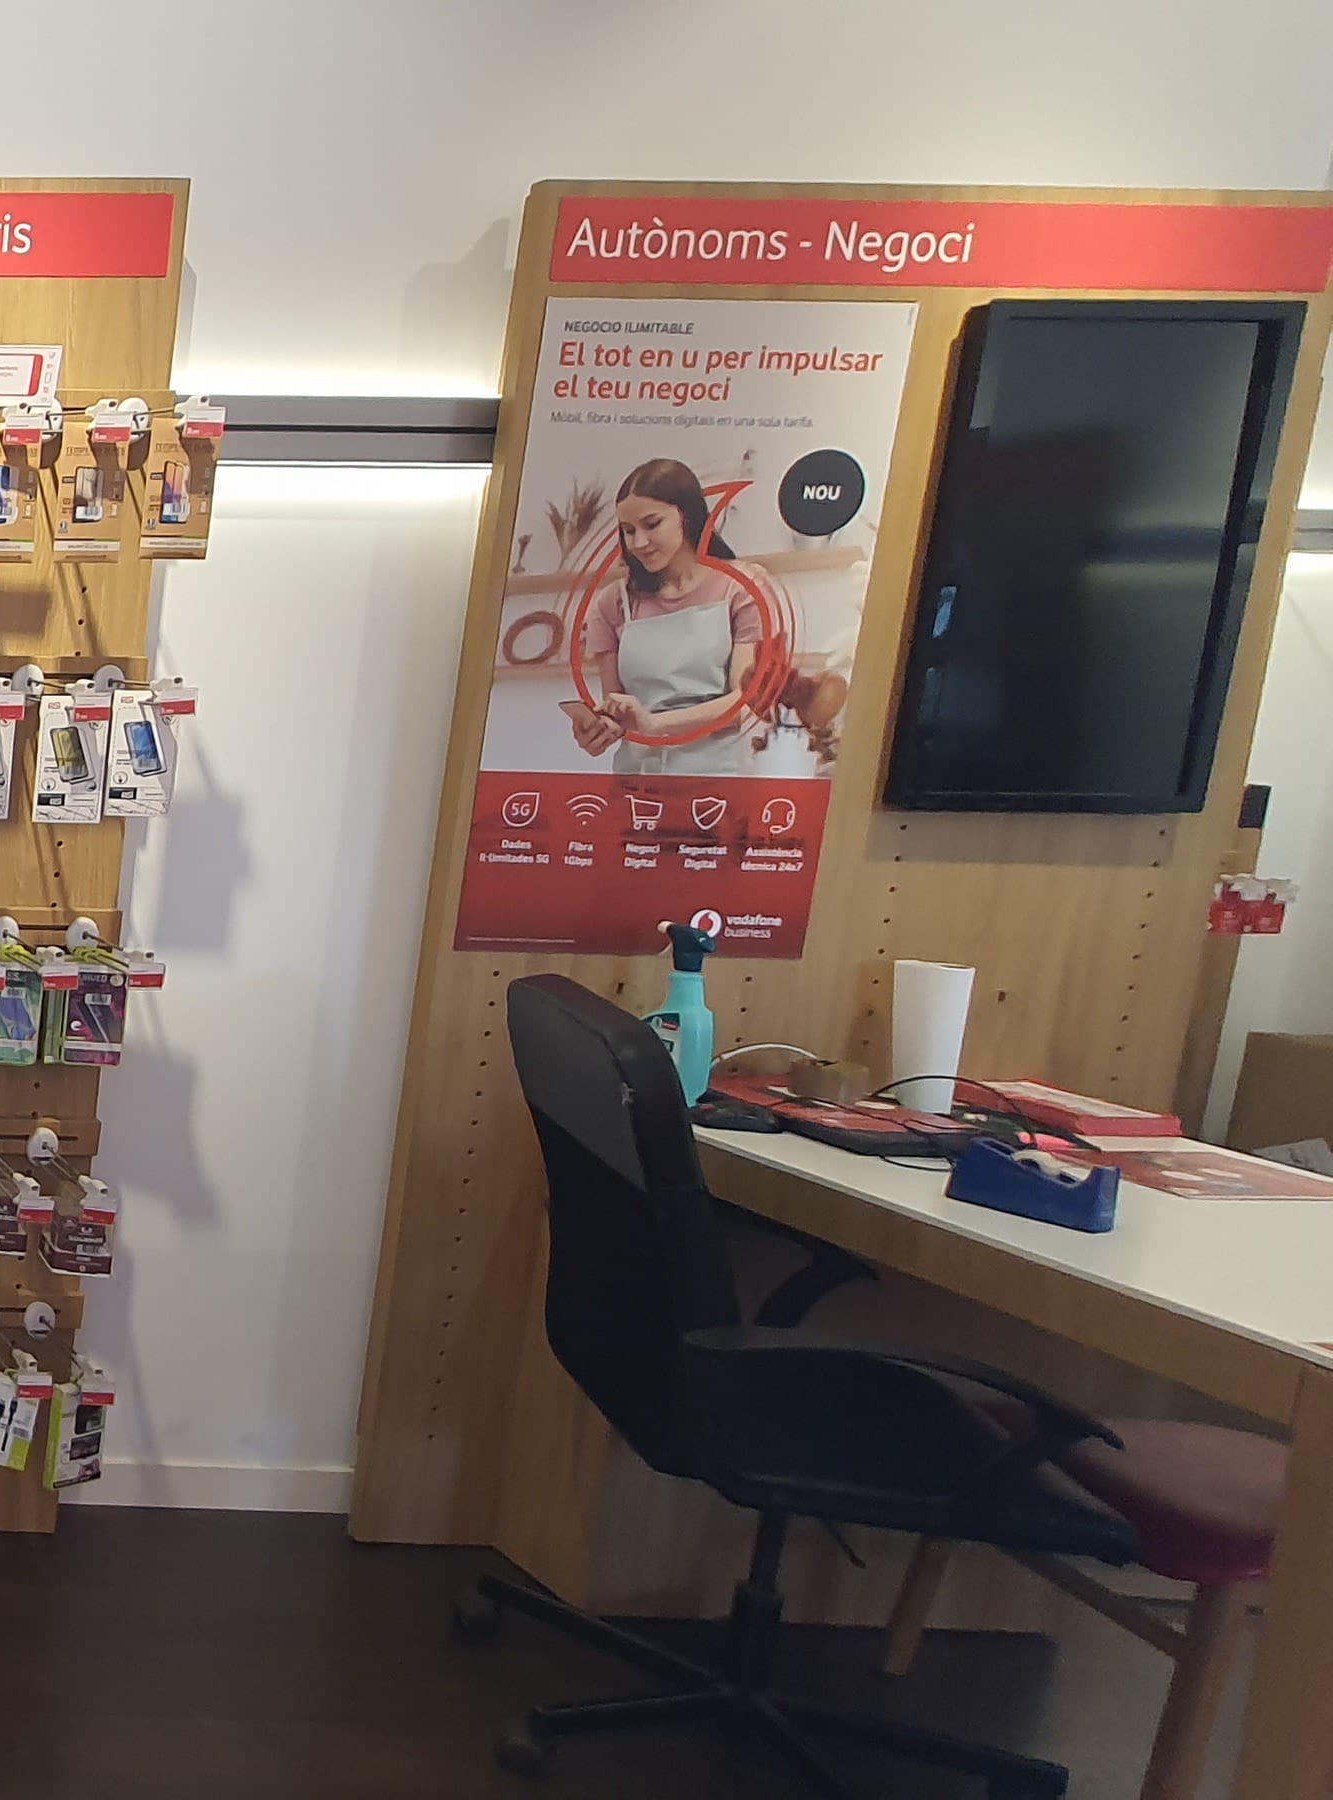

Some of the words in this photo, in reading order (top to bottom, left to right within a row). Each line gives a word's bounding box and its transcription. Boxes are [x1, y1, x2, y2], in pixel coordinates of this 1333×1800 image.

[565, 216, 789, 262] Autònoms
[824, 221, 975, 273] Negoci
[564, 320, 622, 334] NEGOCIO
[624, 322, 695, 335] ILIMITABLE
[559, 341, 585, 367] El
[594, 343, 632, 367] tot
[639, 348, 673, 368] en
[681, 350, 699, 369] u
[705, 349, 753, 374] per
[758, 345, 884, 376] impulsar
[553, 375, 578, 399] el
[587, 377, 631, 399] teu
[638, 377, 731, 407] negoci
[619, 412, 672, 425] solucions
[802, 483, 841, 502] NOU
[510, 803, 530, 817] 5G
[501, 838, 532, 850] Dades
[568, 841, 594, 852] Fibra
[535, 854, 550, 865] 5G
[624, 855, 658, 869] Digital
[683, 857, 718, 871] Digital
[726, 914, 782, 927] vodafone
[724, 925, 772, 939] business
